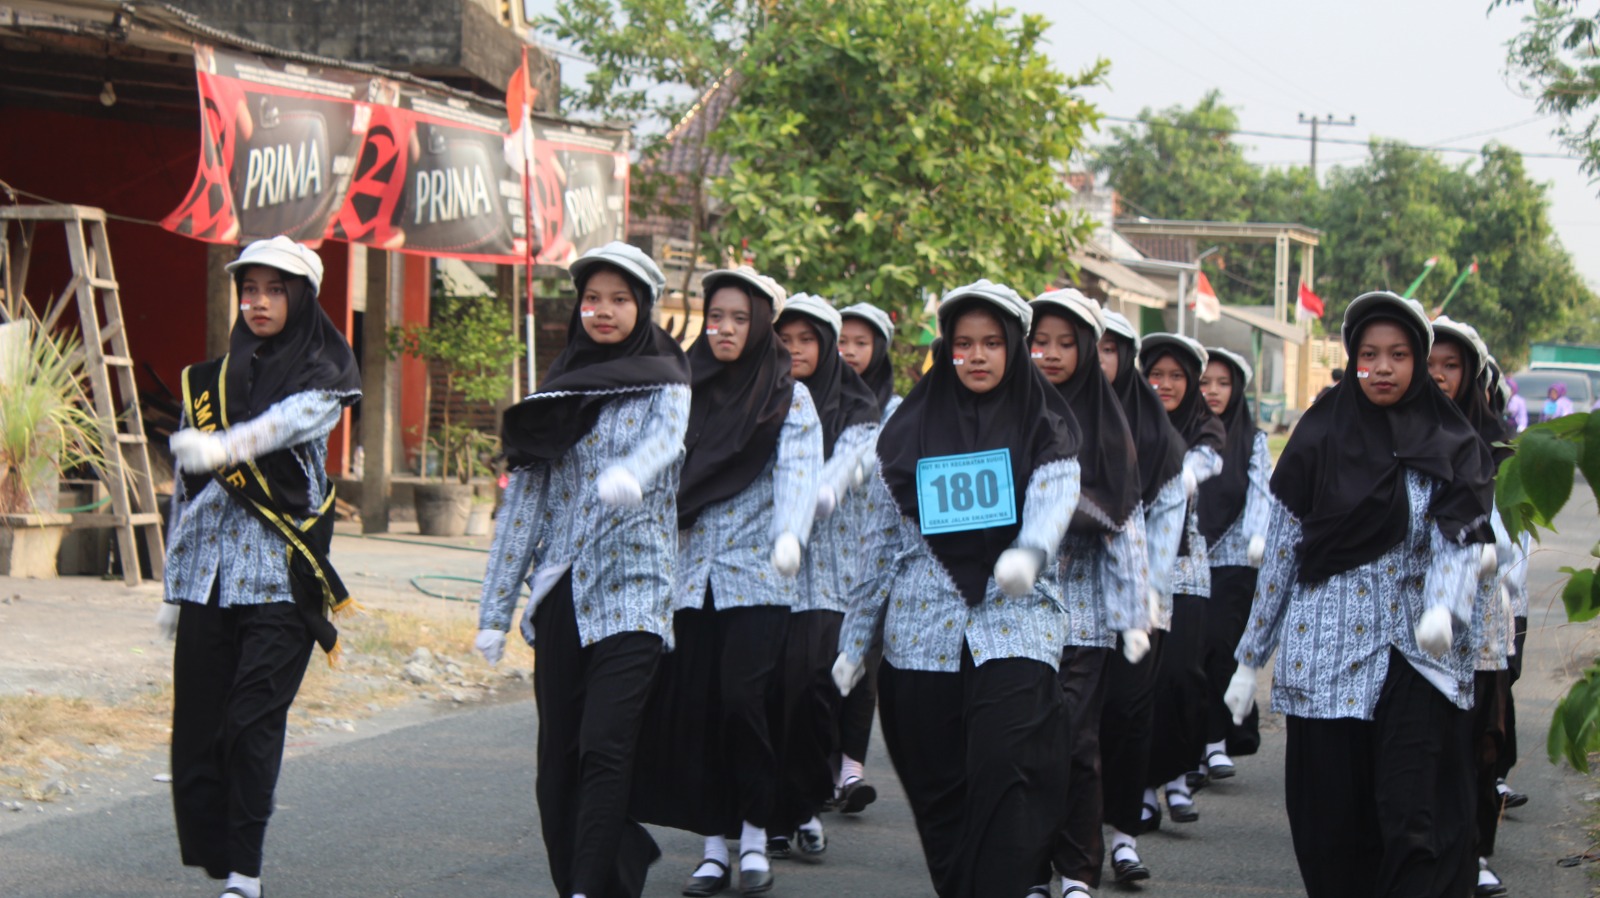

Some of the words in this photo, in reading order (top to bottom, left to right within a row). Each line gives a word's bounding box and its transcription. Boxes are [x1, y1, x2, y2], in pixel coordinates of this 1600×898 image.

[242, 138, 321, 210] PRIMA
[414, 164, 492, 225] PRIMA
[930, 469, 999, 513] 180
